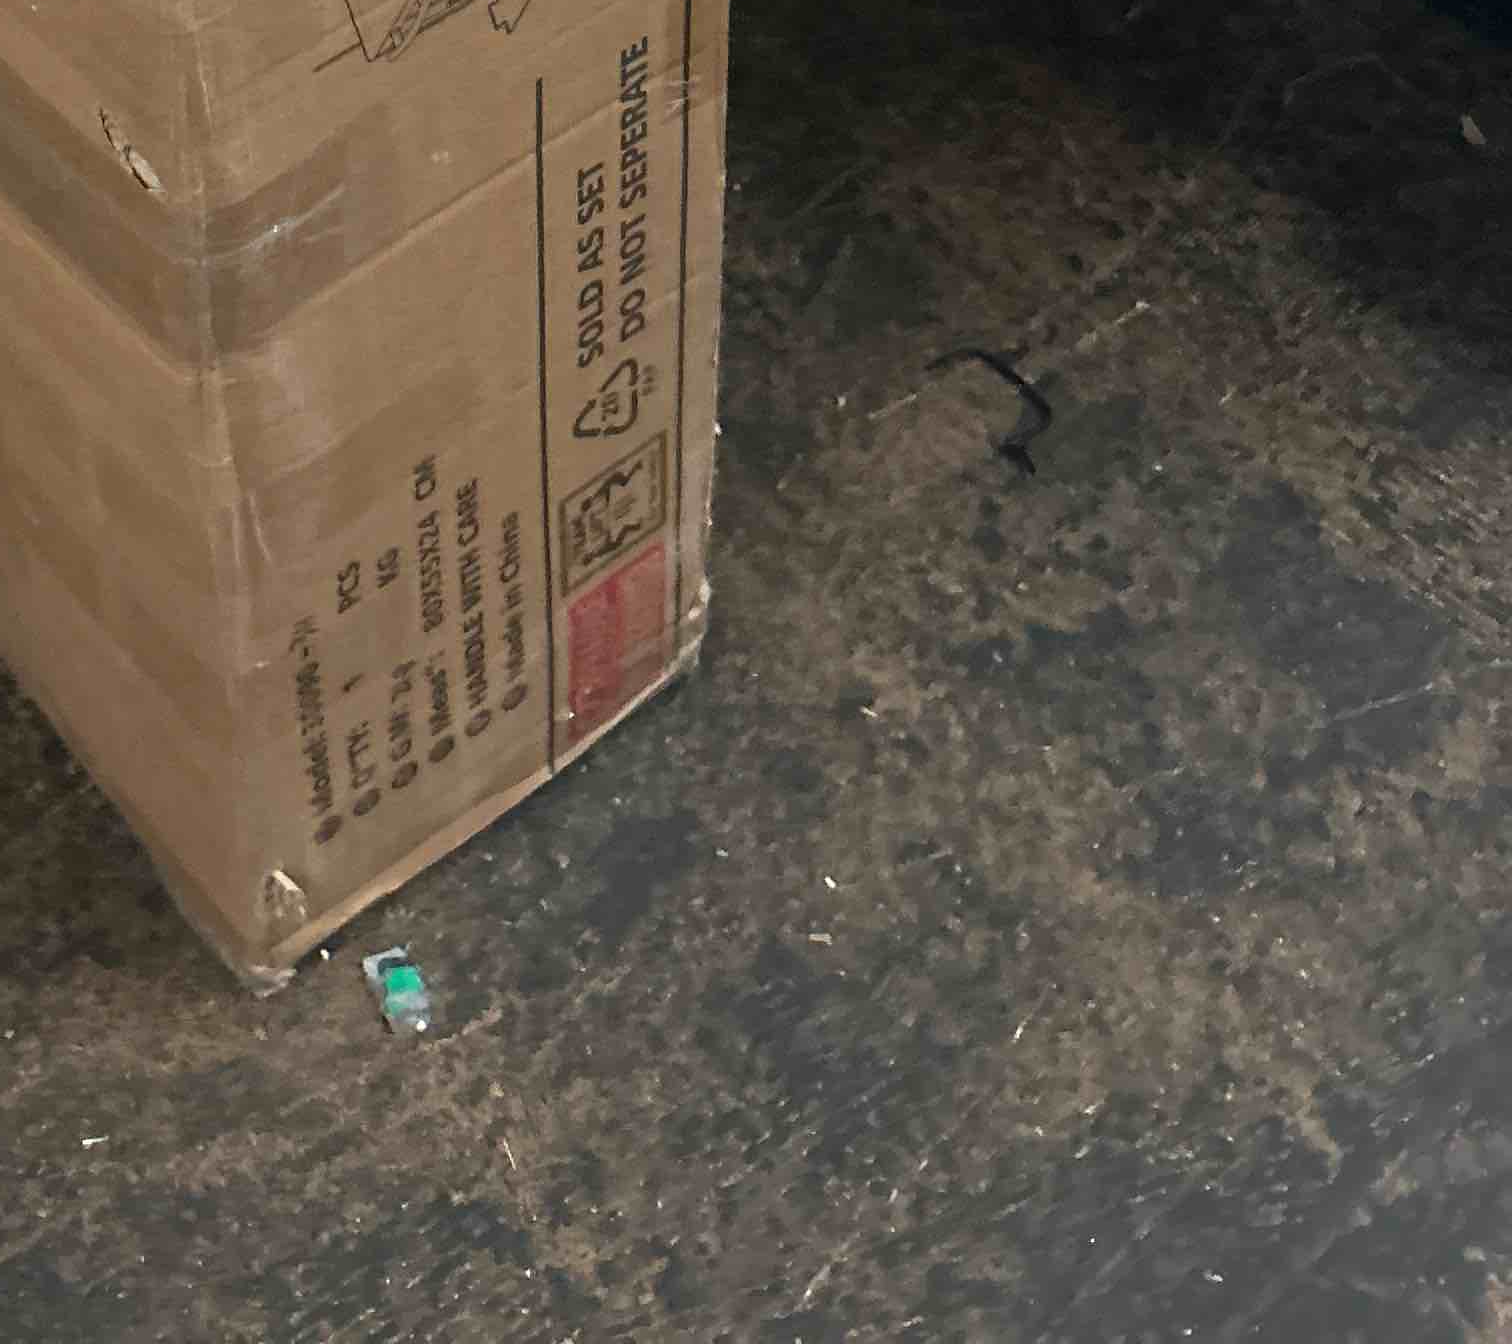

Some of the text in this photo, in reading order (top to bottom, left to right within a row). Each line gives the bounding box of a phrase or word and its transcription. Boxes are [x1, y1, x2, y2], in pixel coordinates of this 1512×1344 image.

[619, 35, 649, 344] DO NOT SEPERATE
[577, 160, 605, 369] SOLD AS SET
[413, 452, 437, 502] CM
[336, 560, 360, 615] PCS
[455, 477, 489, 710] HANDLE WITH CARE
[498, 512, 521, 583] China
